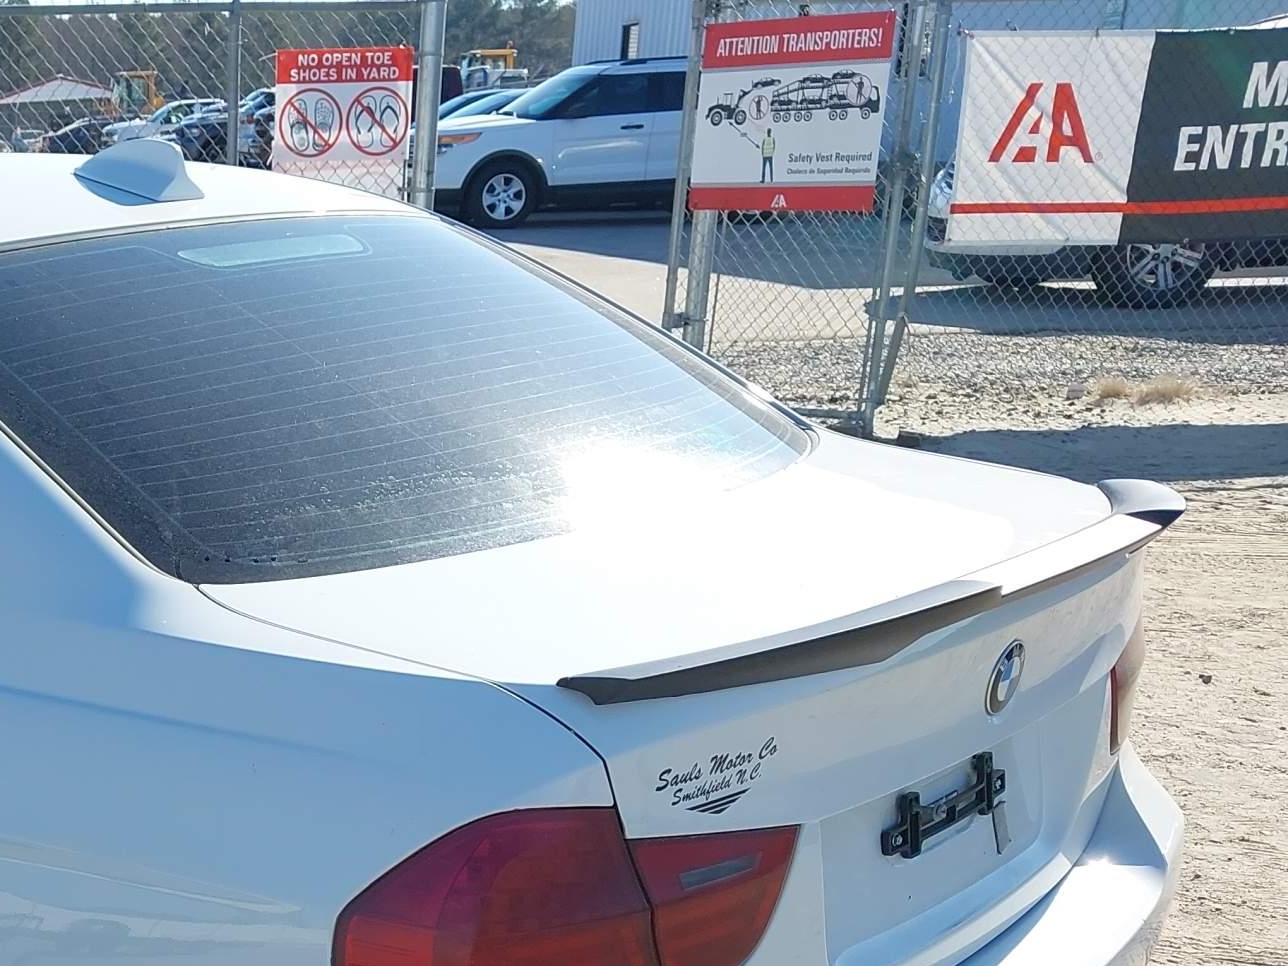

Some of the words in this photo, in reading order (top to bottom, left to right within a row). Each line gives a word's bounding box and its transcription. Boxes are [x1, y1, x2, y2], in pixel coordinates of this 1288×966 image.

[717, 36, 779, 57] ATTENTION
[782, 28, 883, 52] TRANSPORTERS!
[290, 68, 337, 81] SHOES
[342, 68, 356, 80] IN
[362, 66, 399, 79] YARD
[298, 54, 318, 66] NO
[322, 53, 361, 65] OPEN
[365, 52, 393, 65] TOE
[1243, 61, 1288, 108] M
[788, 153, 813, 165] Safety
[816, 152, 832, 162] Vest
[835, 151, 872, 164] Required
[1173, 121, 1288, 171] ENTR
[655, 762, 703, 792] Sauls
[710, 752, 754, 776] Motor
[758, 736, 779, 760] Co
[671, 775, 732, 806] Smithfield
